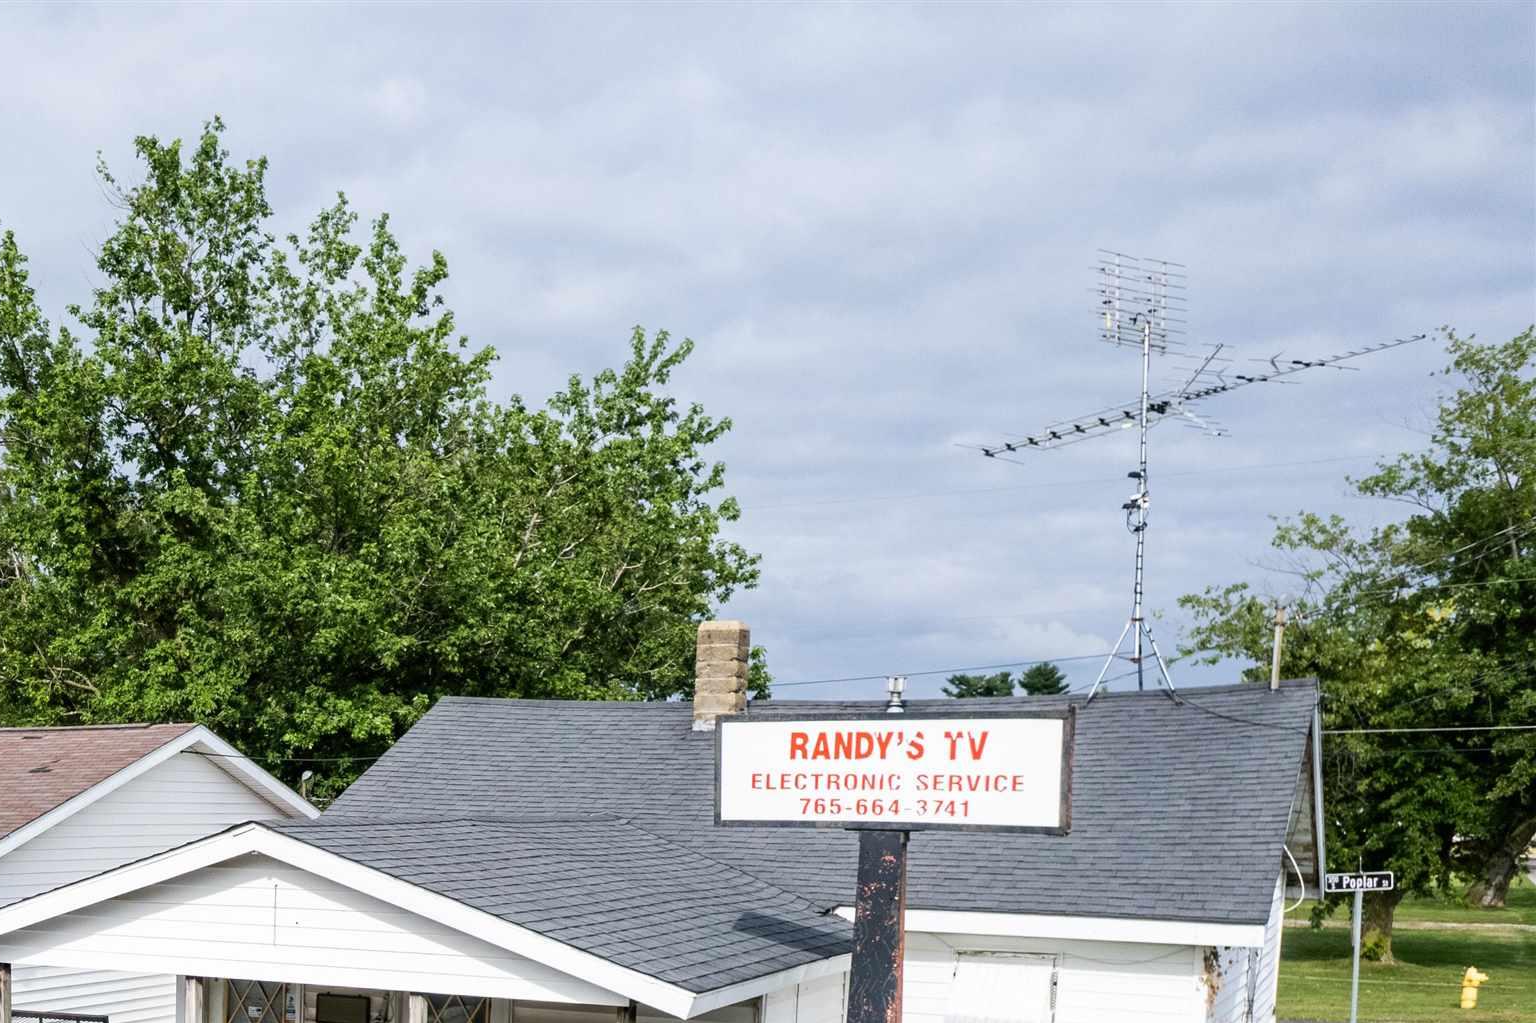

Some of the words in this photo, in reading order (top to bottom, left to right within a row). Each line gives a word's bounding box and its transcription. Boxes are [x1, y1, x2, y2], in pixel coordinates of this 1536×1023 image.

[790, 731, 924, 761] RANDY'S
[752, 773, 901, 790] ELECTRONIC
[916, 774, 1024, 792] SERVICE
[800, 798, 969, 817] 765-664-3741
[1343, 876, 1378, 889] Poplar
